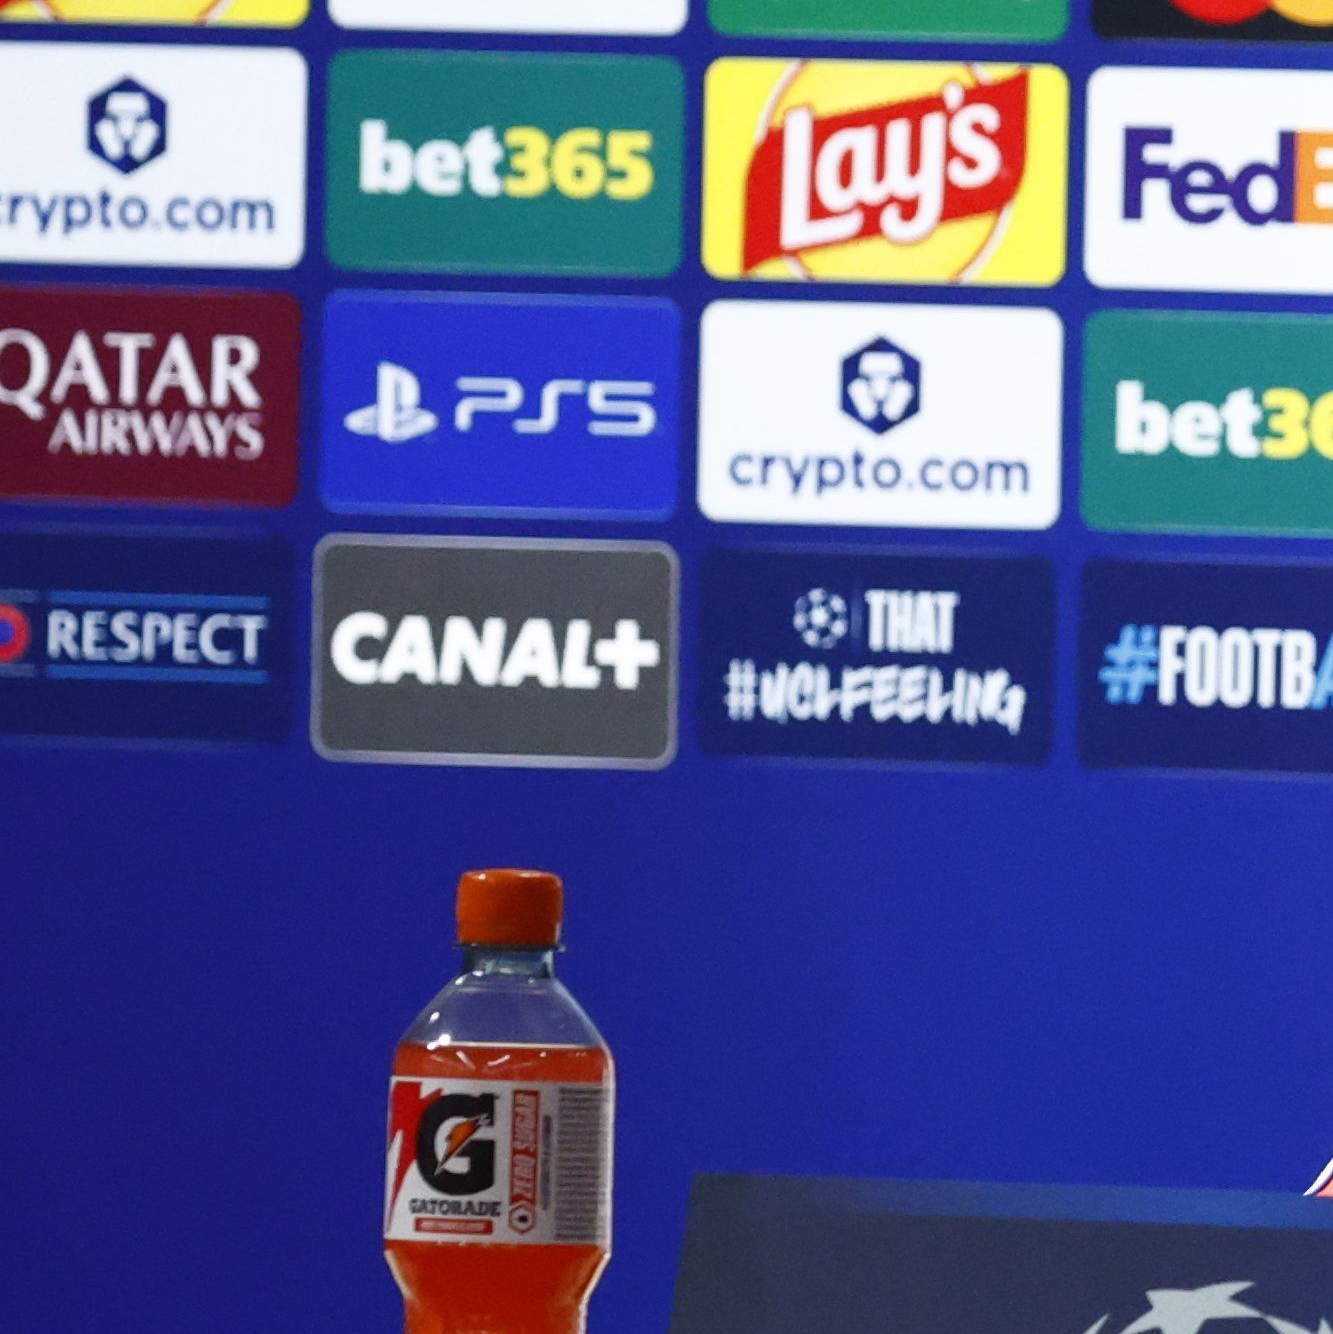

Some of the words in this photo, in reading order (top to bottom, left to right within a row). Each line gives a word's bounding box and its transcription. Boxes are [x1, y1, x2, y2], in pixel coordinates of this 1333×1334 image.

[360, 120, 654, 200] bet365
[780, 79, 1000, 250] Lay's
[0, 190, 275, 236] rypto.com
[0, 328, 262, 422] QATAR
[455, 377, 656, 436] PS5
[47, 409, 265, 458] AIRWAYS
[728, 449, 1030, 496] crypto.com
[46, 609, 268, 664] RESPECT
[331, 612, 659, 689] CANAL+
[865, 590, 959, 653] THAT
[724, 658, 1027, 734] #UCLFEELING
[416, 1093, 499, 1196] G
[409, 1198, 502, 1217] GATORADE
